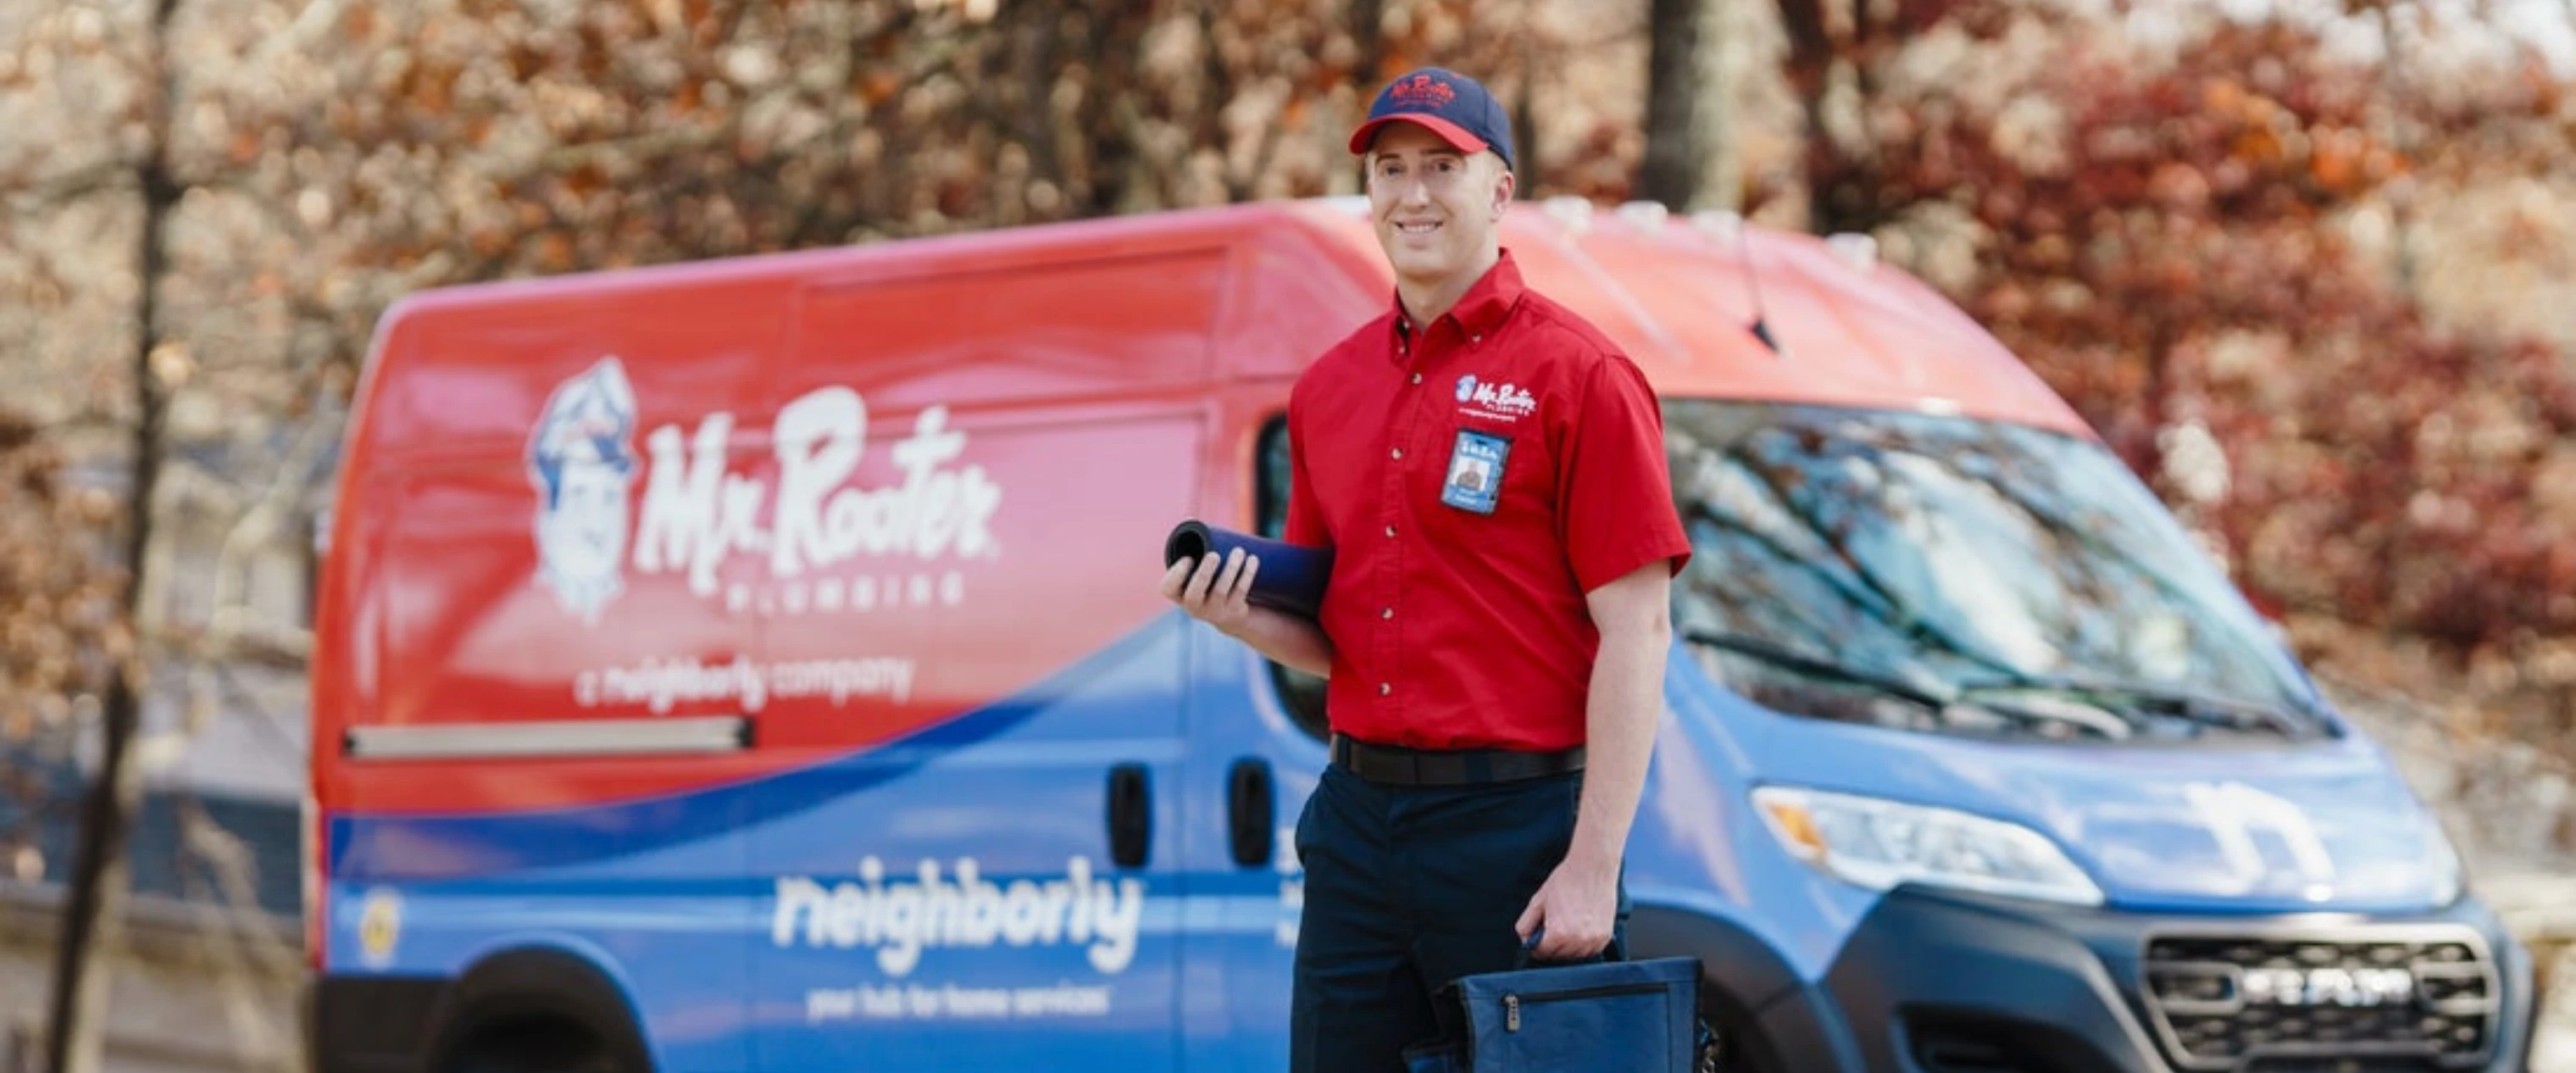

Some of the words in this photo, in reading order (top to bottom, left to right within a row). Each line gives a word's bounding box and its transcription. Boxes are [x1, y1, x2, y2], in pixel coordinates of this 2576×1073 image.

[634, 412, 773, 595] Mr.
[771, 385, 1001, 575] Rooter
[604, 656, 764, 712] neighborly
[771, 657, 915, 705] company
[772, 855, 1143, 976] neighborly
